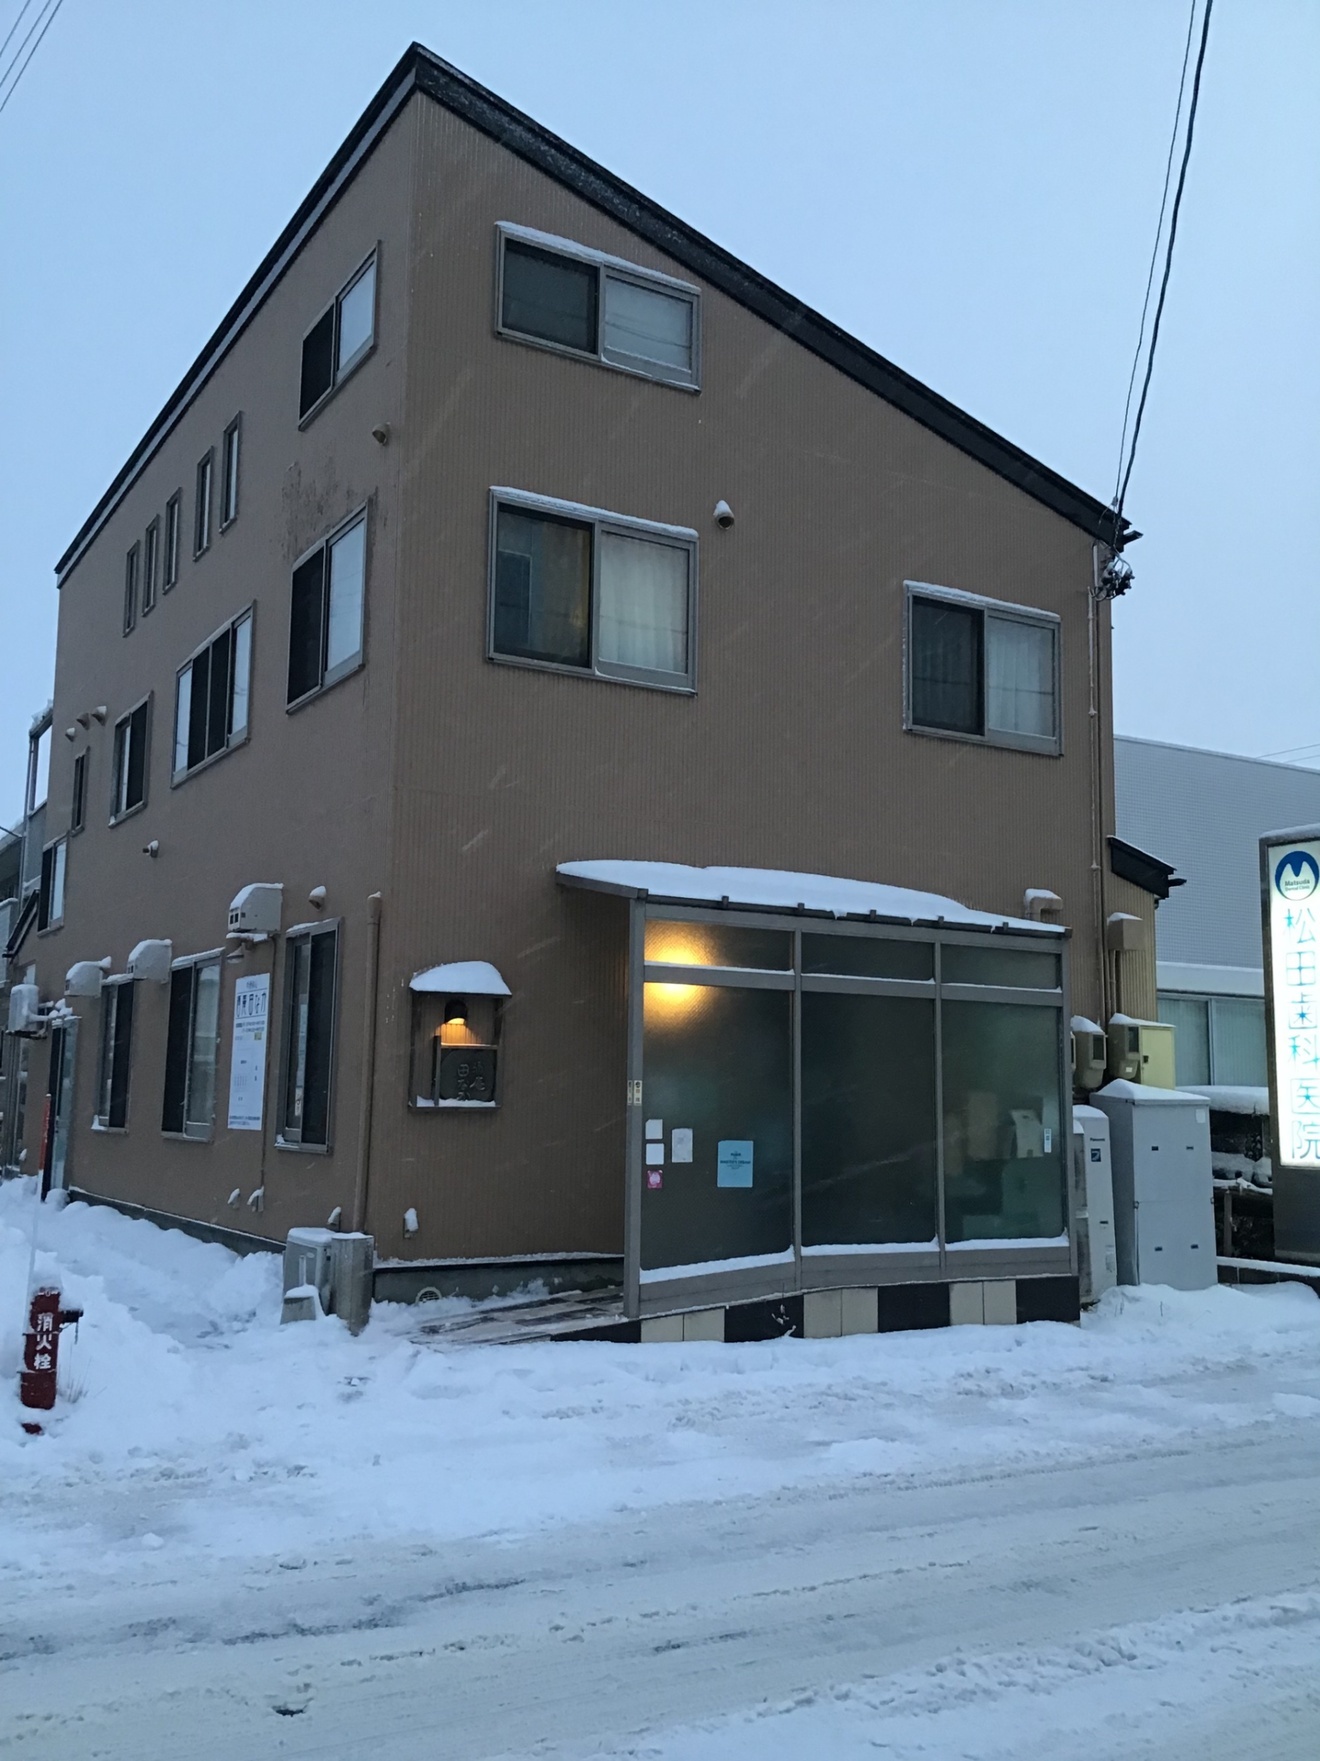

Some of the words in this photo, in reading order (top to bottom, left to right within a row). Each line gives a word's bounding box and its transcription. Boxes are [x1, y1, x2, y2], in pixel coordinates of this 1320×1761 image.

[1284, 879, 1310, 887] Matsuda
[1283, 906, 1320, 1162] 松田歯科医院
[33, 1311, 55, 1371] 消火栓
